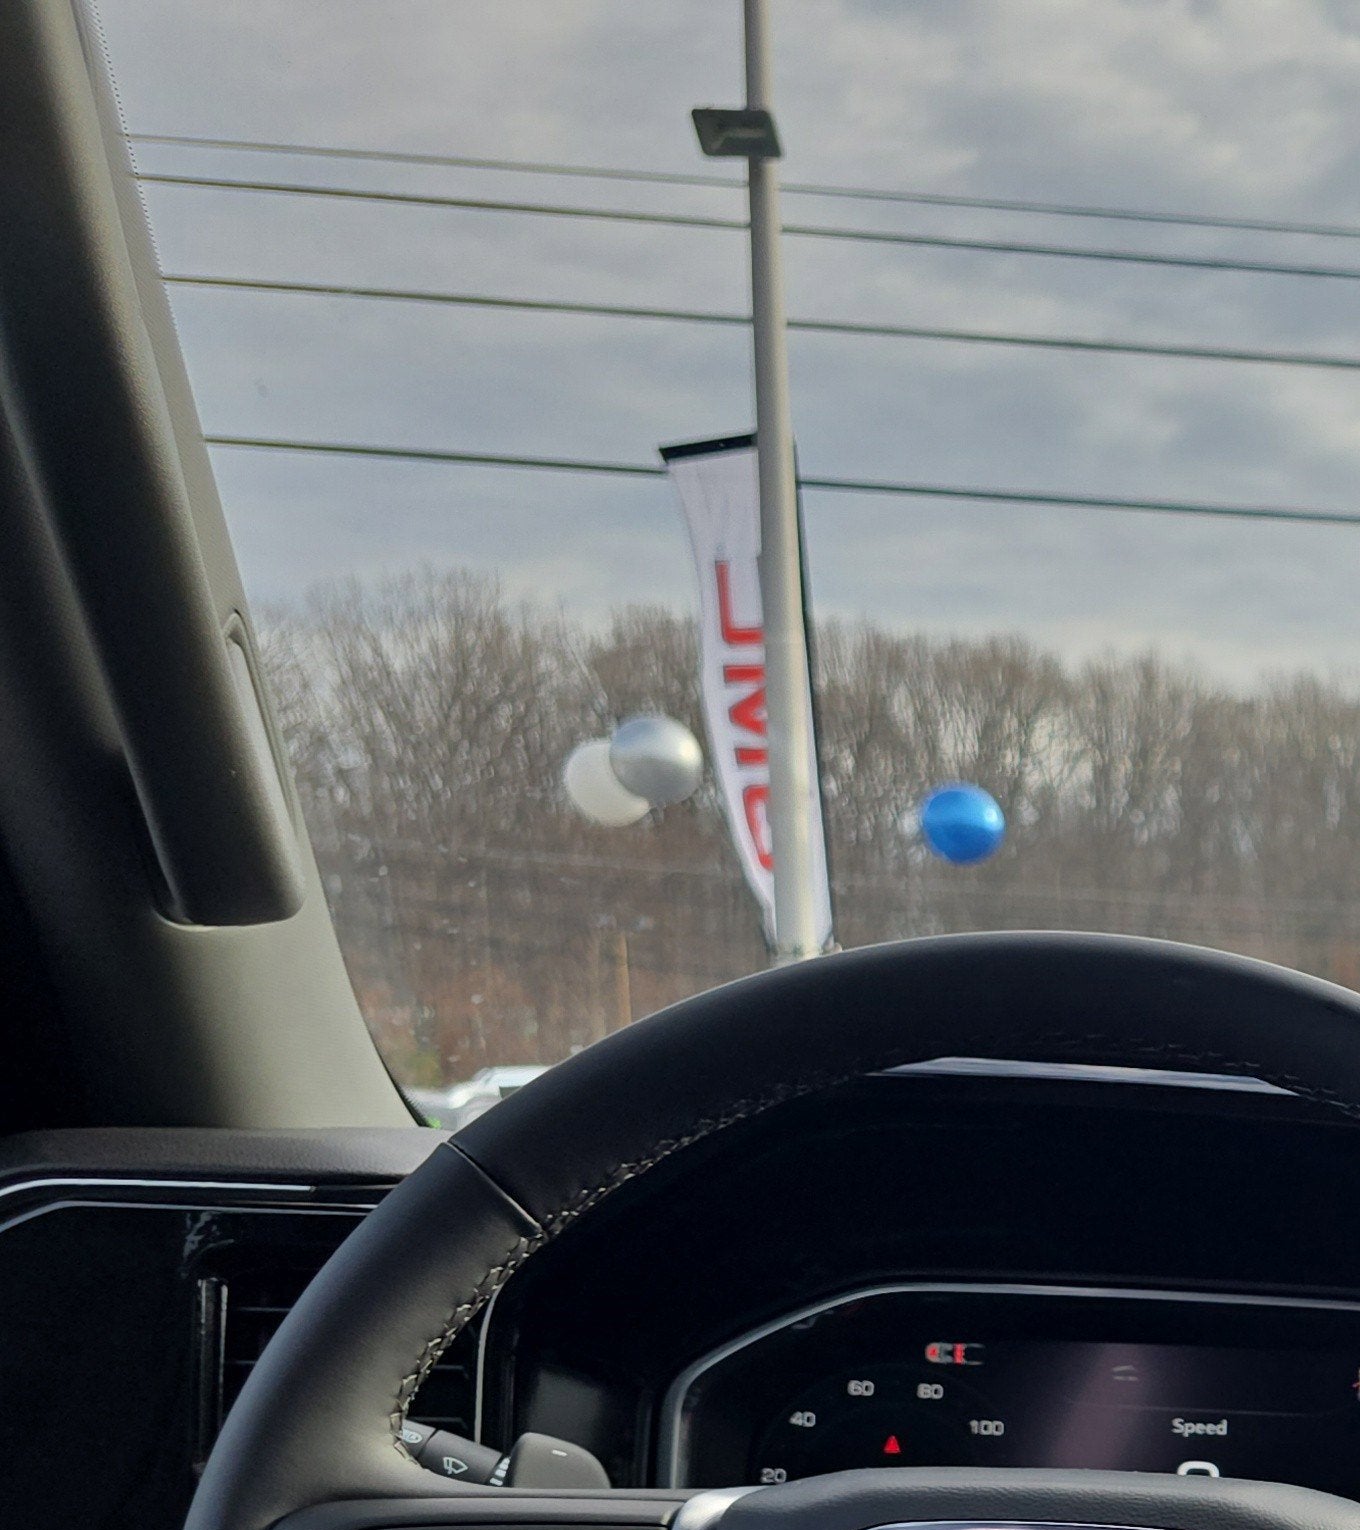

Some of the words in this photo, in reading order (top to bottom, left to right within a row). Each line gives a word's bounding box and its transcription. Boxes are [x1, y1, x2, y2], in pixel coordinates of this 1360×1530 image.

[847, 1380, 875, 1397] 60
[916, 1383, 944, 1399] 80
[789, 1411, 816, 1427] 40
[1171, 1417, 1228, 1437] Speed
[969, 1420, 1005, 1436] 100
